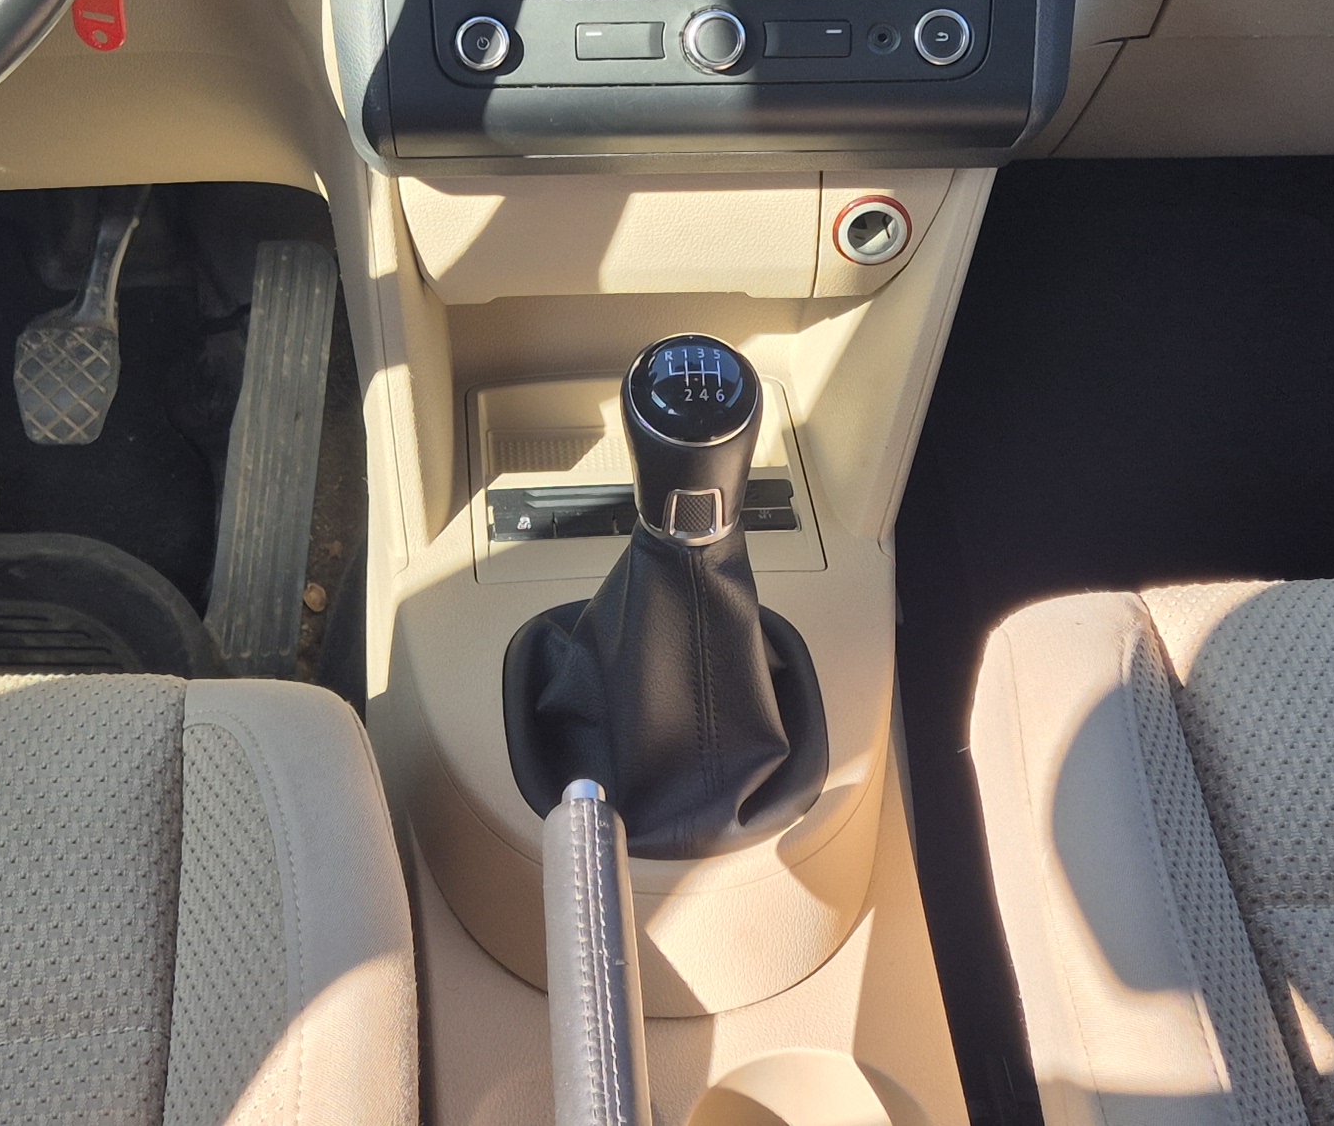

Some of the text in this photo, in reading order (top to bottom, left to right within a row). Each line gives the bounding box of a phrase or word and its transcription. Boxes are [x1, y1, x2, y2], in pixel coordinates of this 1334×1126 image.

[664, 348, 721, 361] R 1 3 5
[683, 388, 726, 402] 2 4 6
